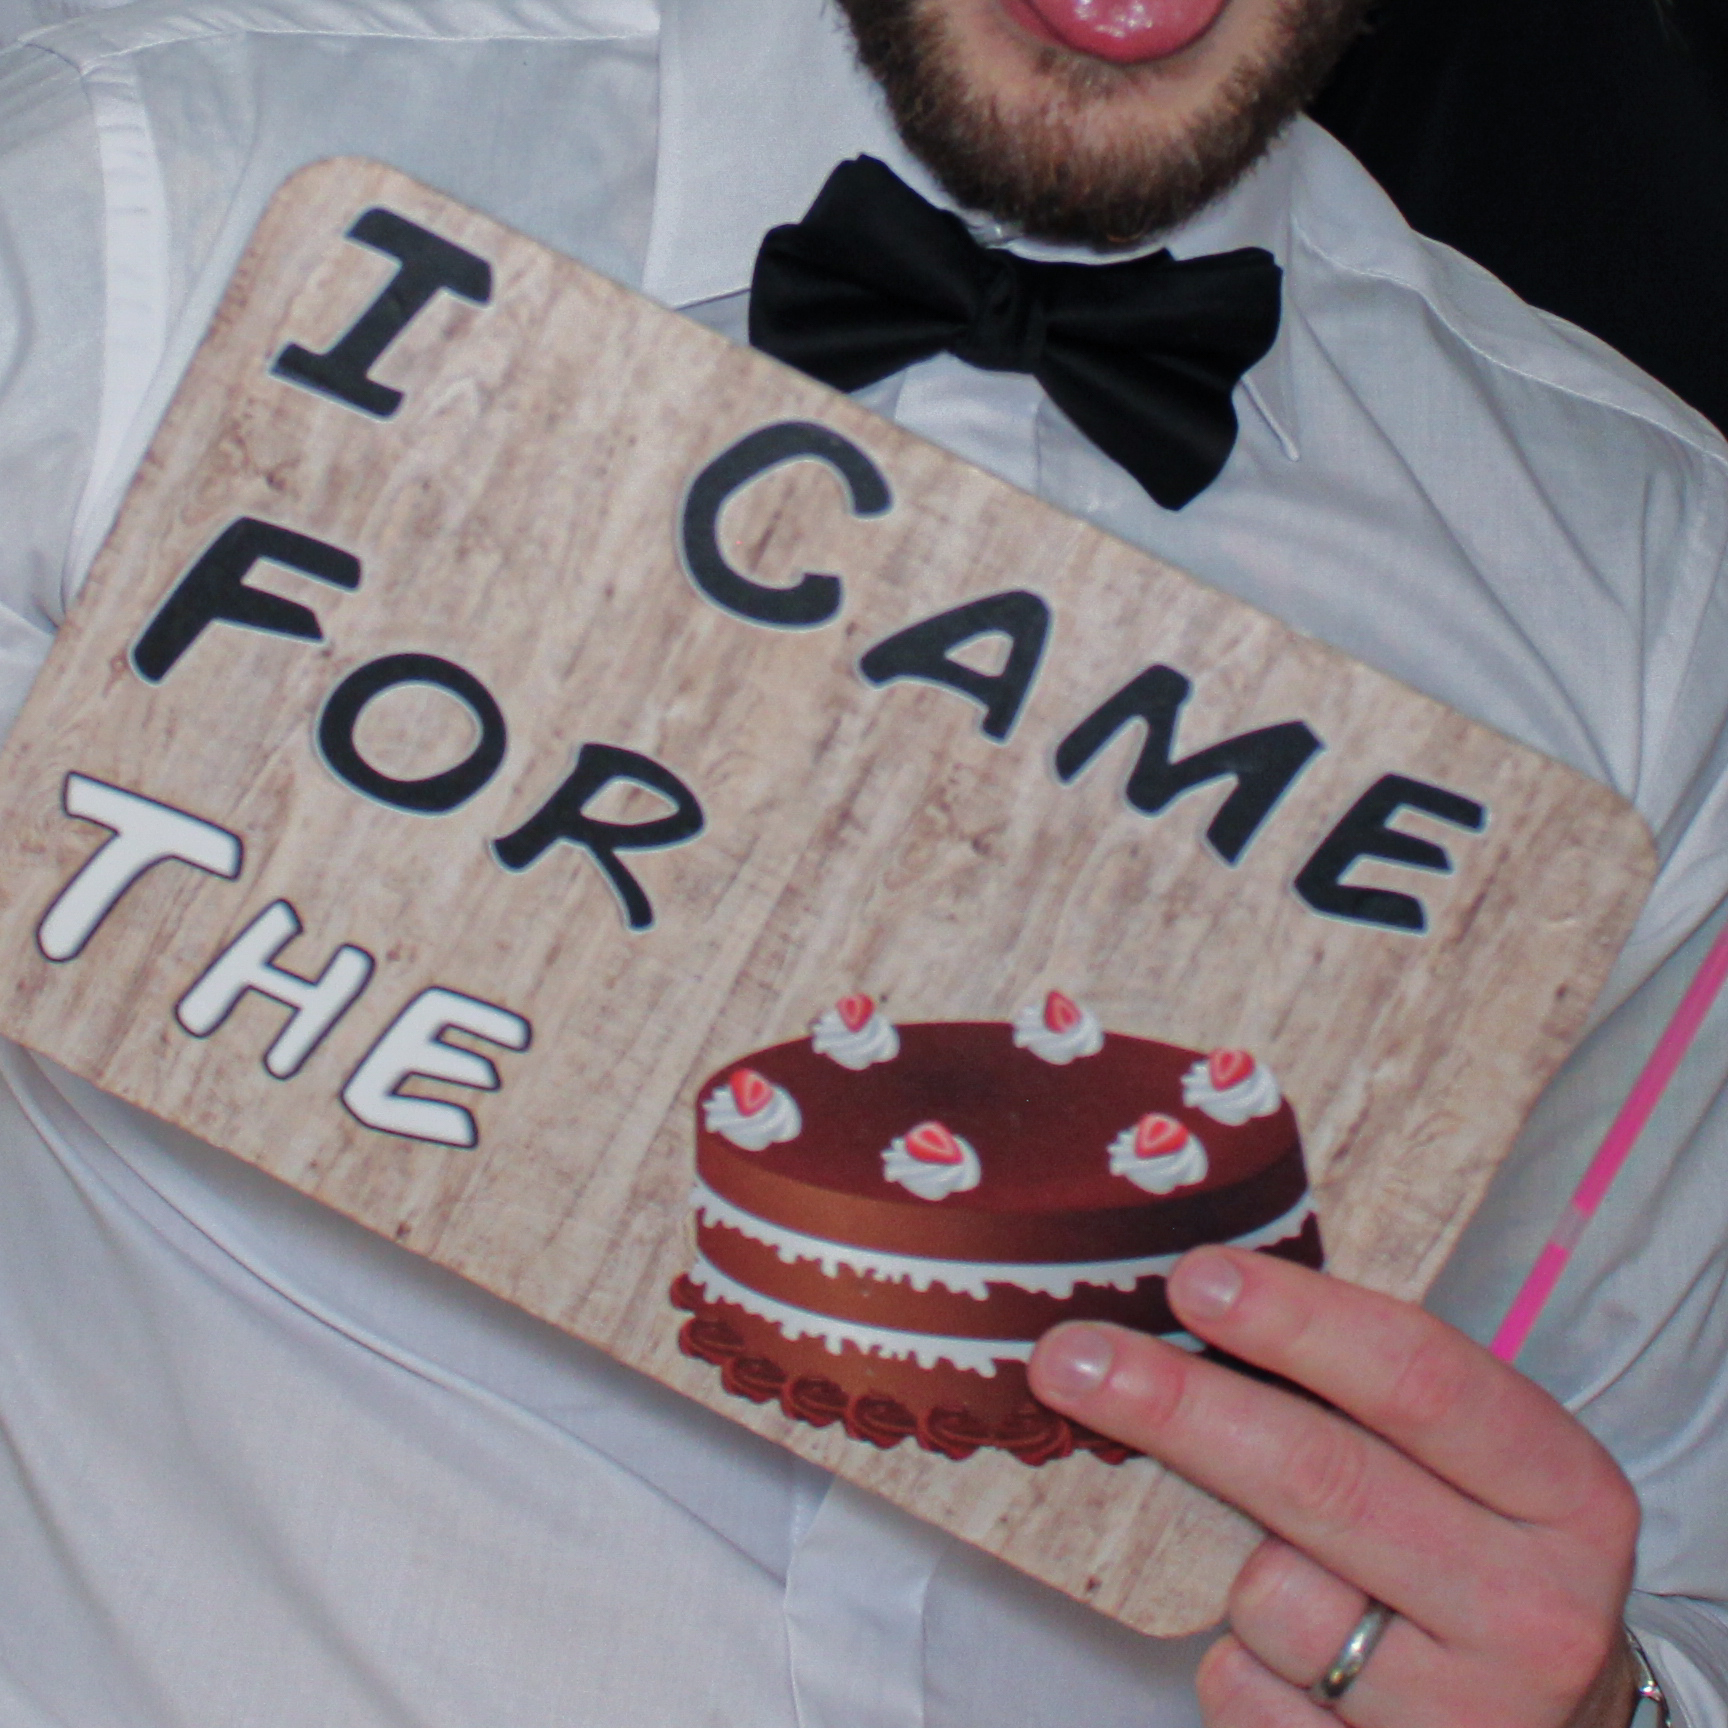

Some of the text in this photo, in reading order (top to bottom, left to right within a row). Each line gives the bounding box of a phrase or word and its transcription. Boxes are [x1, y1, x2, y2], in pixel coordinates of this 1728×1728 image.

[134, 518, 704, 927] FOR
[271, 207, 1486, 933] I CAME
[36, 772, 531, 1147] THE
